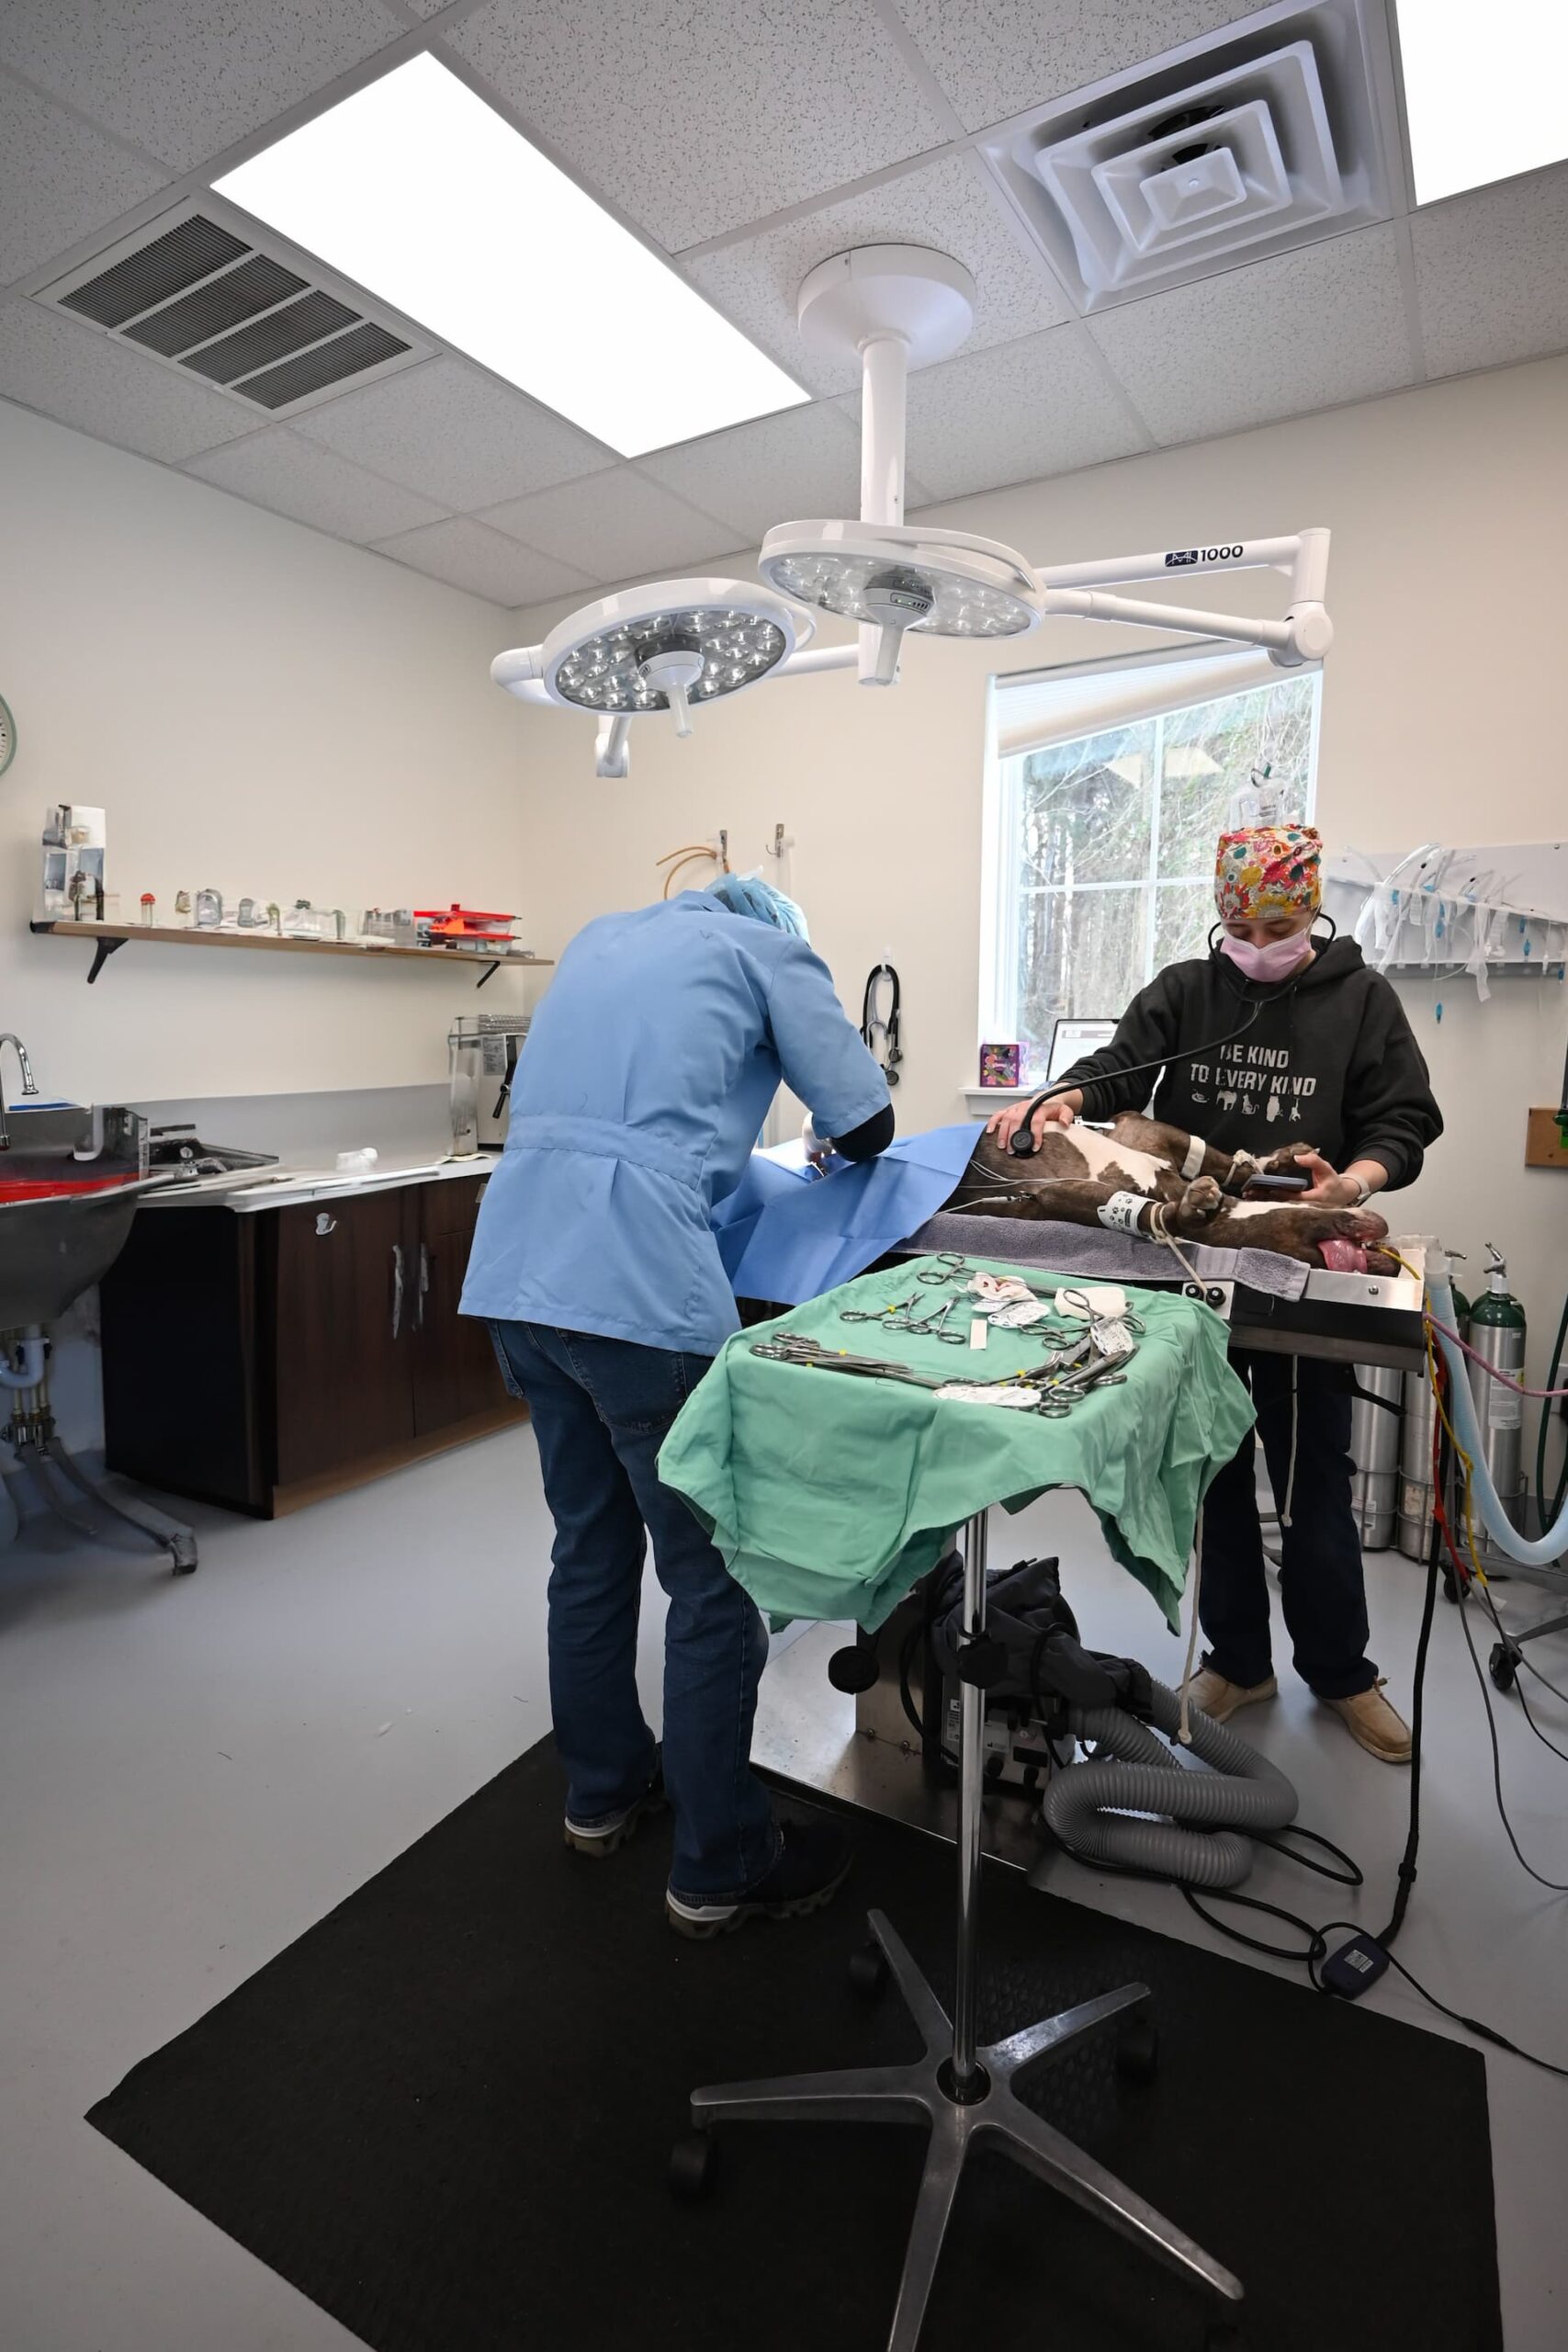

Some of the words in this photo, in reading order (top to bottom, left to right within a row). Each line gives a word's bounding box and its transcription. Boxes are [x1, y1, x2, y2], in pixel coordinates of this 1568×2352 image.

[1201, 545, 1244, 562] 1000
[1247, 1046, 1290, 1069] KIND
[1190, 1063, 1210, 1083] TO
[1270, 1075, 1317, 1097] KIND
